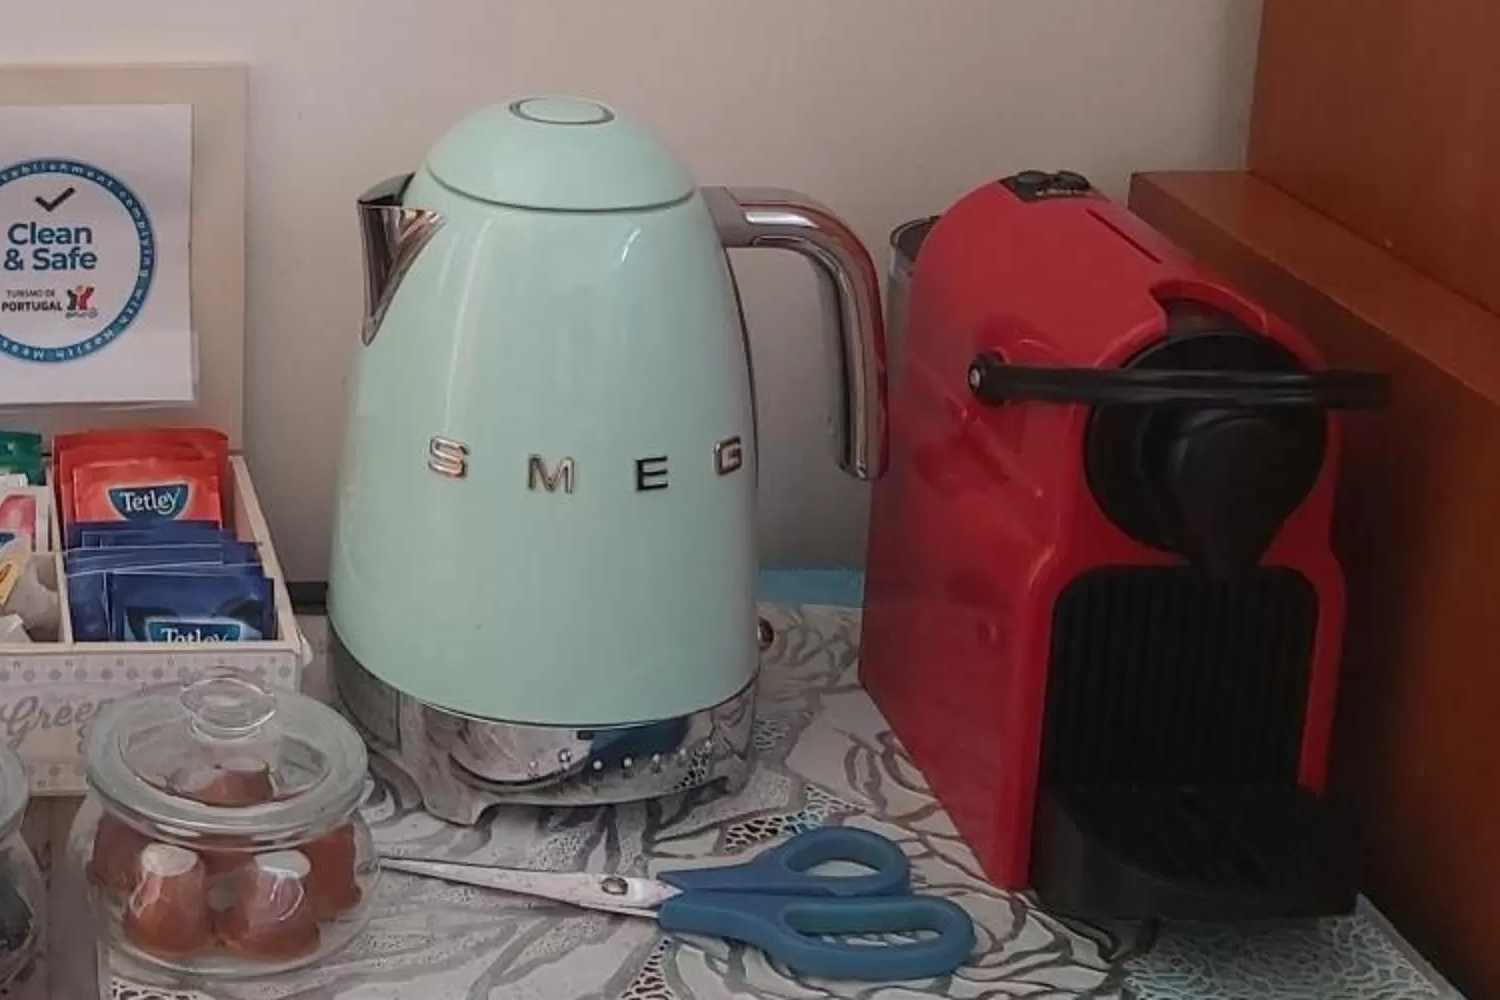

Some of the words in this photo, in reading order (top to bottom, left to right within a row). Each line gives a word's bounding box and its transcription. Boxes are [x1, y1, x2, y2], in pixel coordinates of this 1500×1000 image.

[7, 222, 93, 245] Clean
[3, 248, 24, 271] &
[32, 246, 98, 271] Safe
[6, 288, 43, 298] TURISMO
[1, 301, 63, 313] PORTUGAL
[427, 434, 743, 495] SMEG
[119, 486, 182, 515] Tetley
